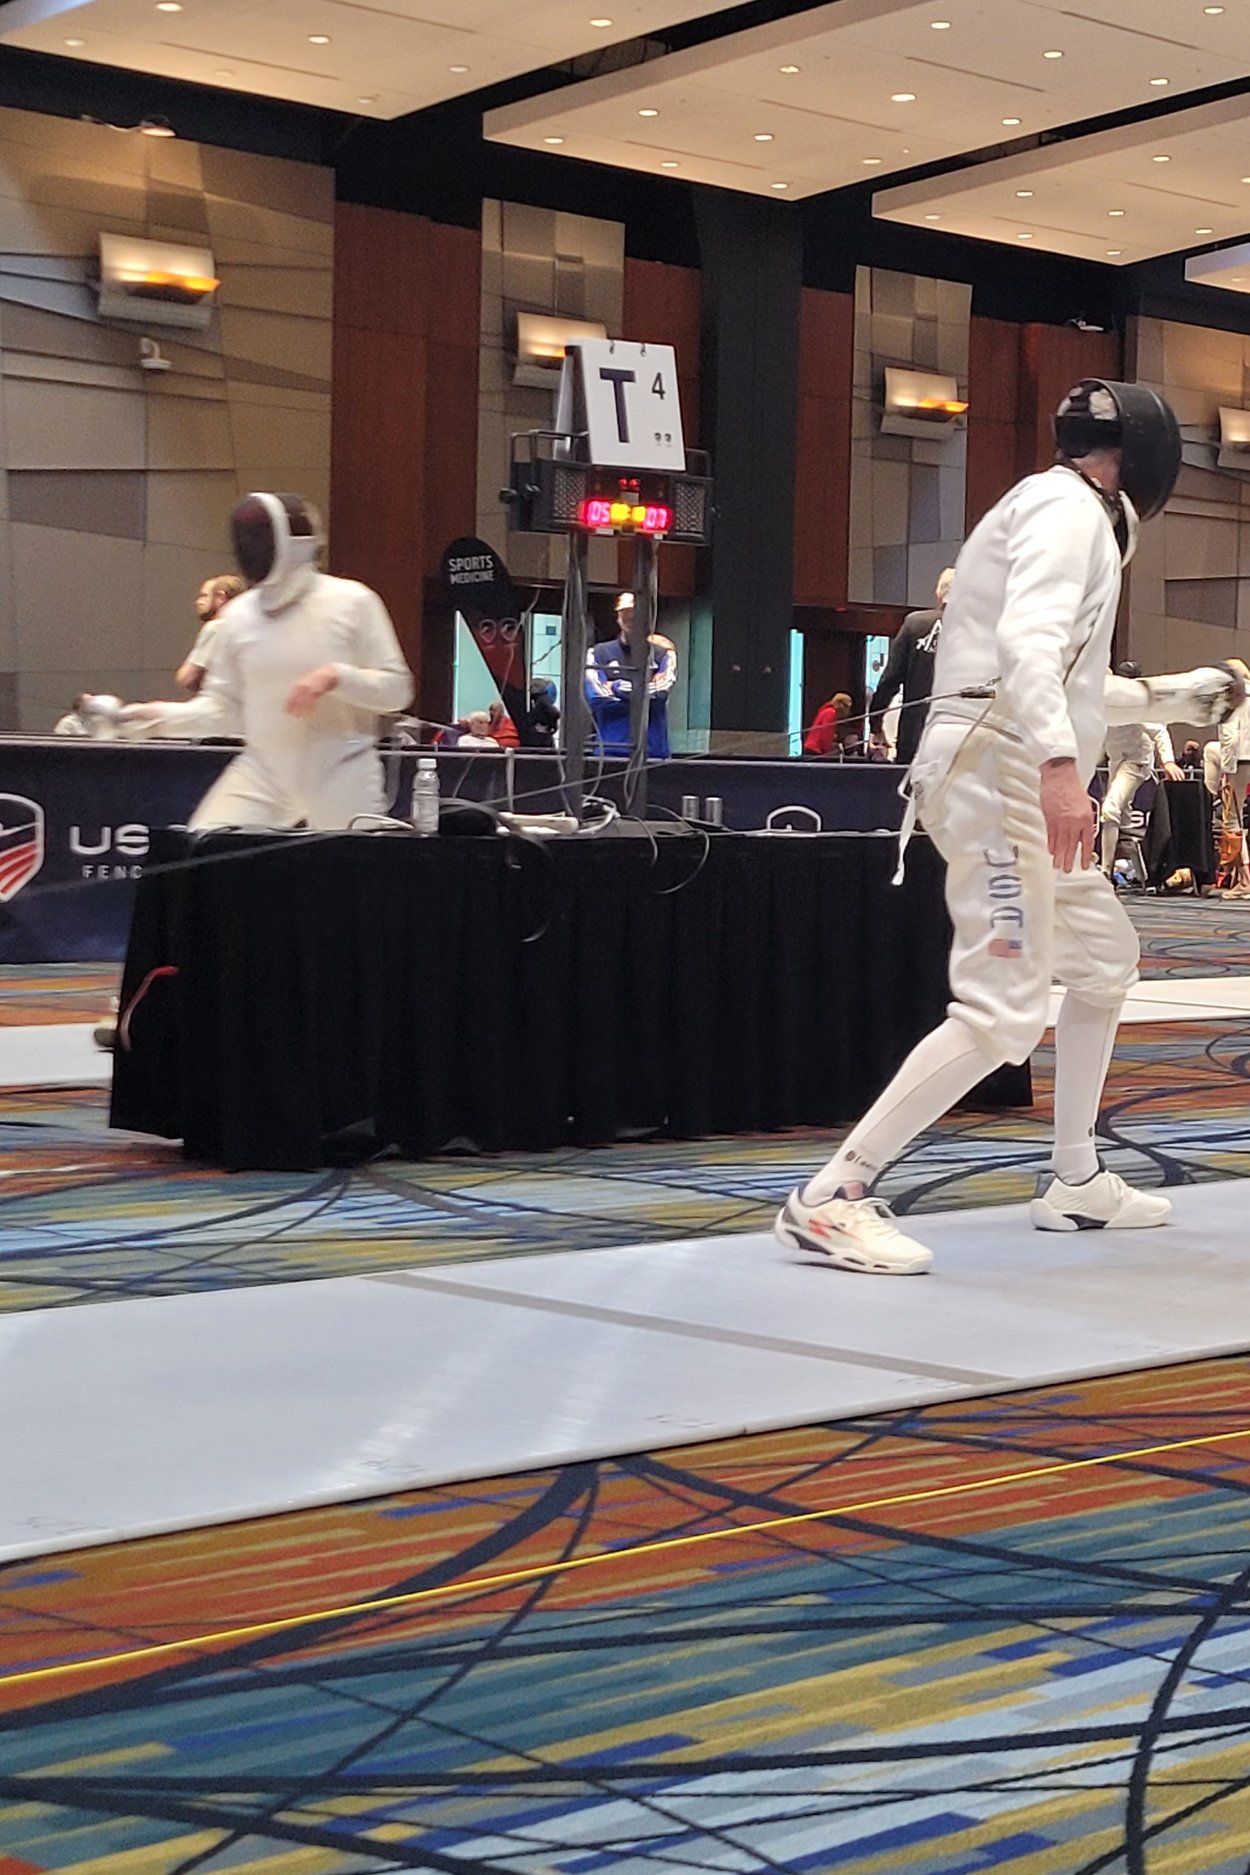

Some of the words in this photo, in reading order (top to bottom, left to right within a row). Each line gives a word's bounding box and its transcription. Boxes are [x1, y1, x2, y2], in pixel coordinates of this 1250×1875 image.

[651, 371, 667, 401] 4
[599, 366, 636, 444] T
[449, 555, 495, 572] SPORTS
[450, 570, 495, 585] MEDICINE
[69, 823, 151, 856] US
[82, 865, 144, 880] FENC
[983, 845, 1025, 930] USA
